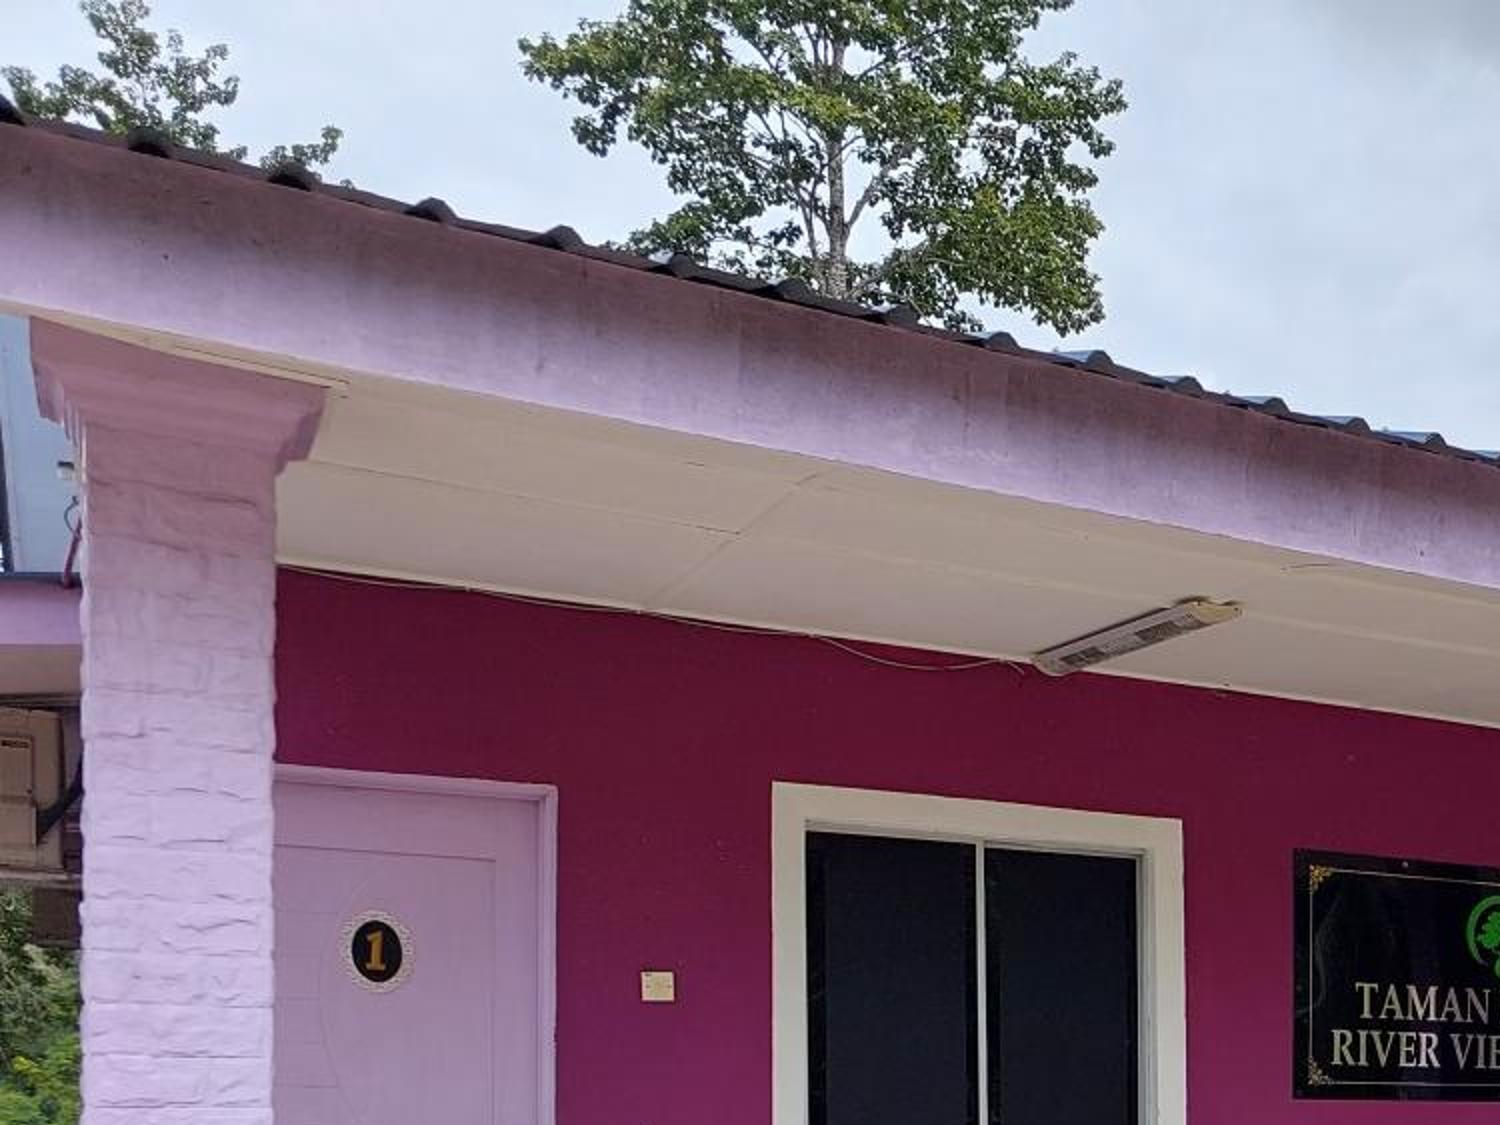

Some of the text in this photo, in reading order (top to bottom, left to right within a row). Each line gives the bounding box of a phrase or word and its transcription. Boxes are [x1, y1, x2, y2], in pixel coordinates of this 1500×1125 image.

[366, 930, 386, 971] 1
[1354, 981, 1491, 1025] TAMAN
[1330, 1028, 1441, 1069] RIVER
